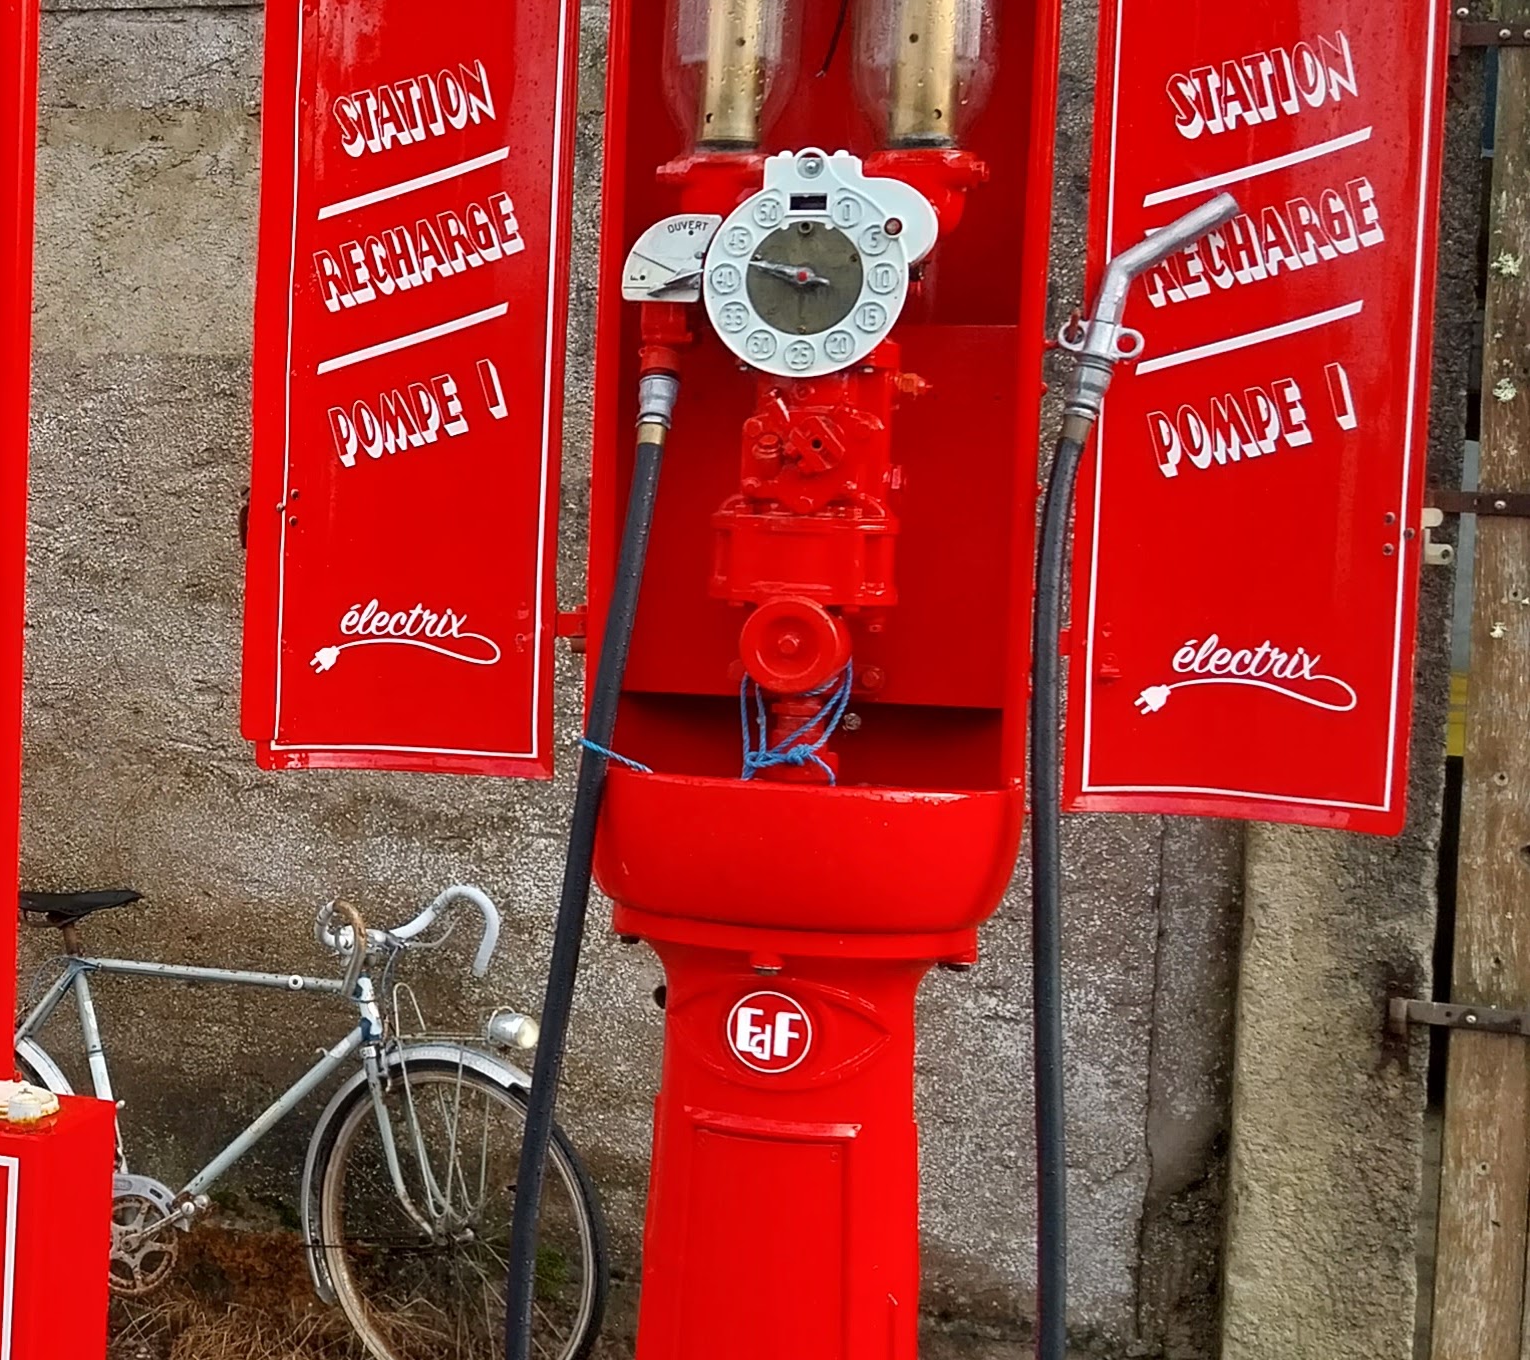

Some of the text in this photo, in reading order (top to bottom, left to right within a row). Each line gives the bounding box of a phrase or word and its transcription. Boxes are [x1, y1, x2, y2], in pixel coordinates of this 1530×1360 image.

[1165, 29, 1360, 140] STATION
[332, 59, 497, 159] STATION
[667, 220, 709, 234] OUVERT
[759, 205, 777, 222] 50
[313, 191, 526, 313] RECHARGE
[729, 231, 747, 248] 45
[1143, 176, 1385, 309] RECHARGE
[717, 269, 734, 288] 40
[876, 270, 890, 289] 10
[863, 307, 879, 326] 15
[790, 346, 810, 365] 25
[831, 335, 848, 355] 20
[328, 373, 469, 468] POMPE
[1147, 377, 1314, 479] POMPE
[339, 598, 468, 640] électrix
[1171, 633, 1323, 682] électrix
